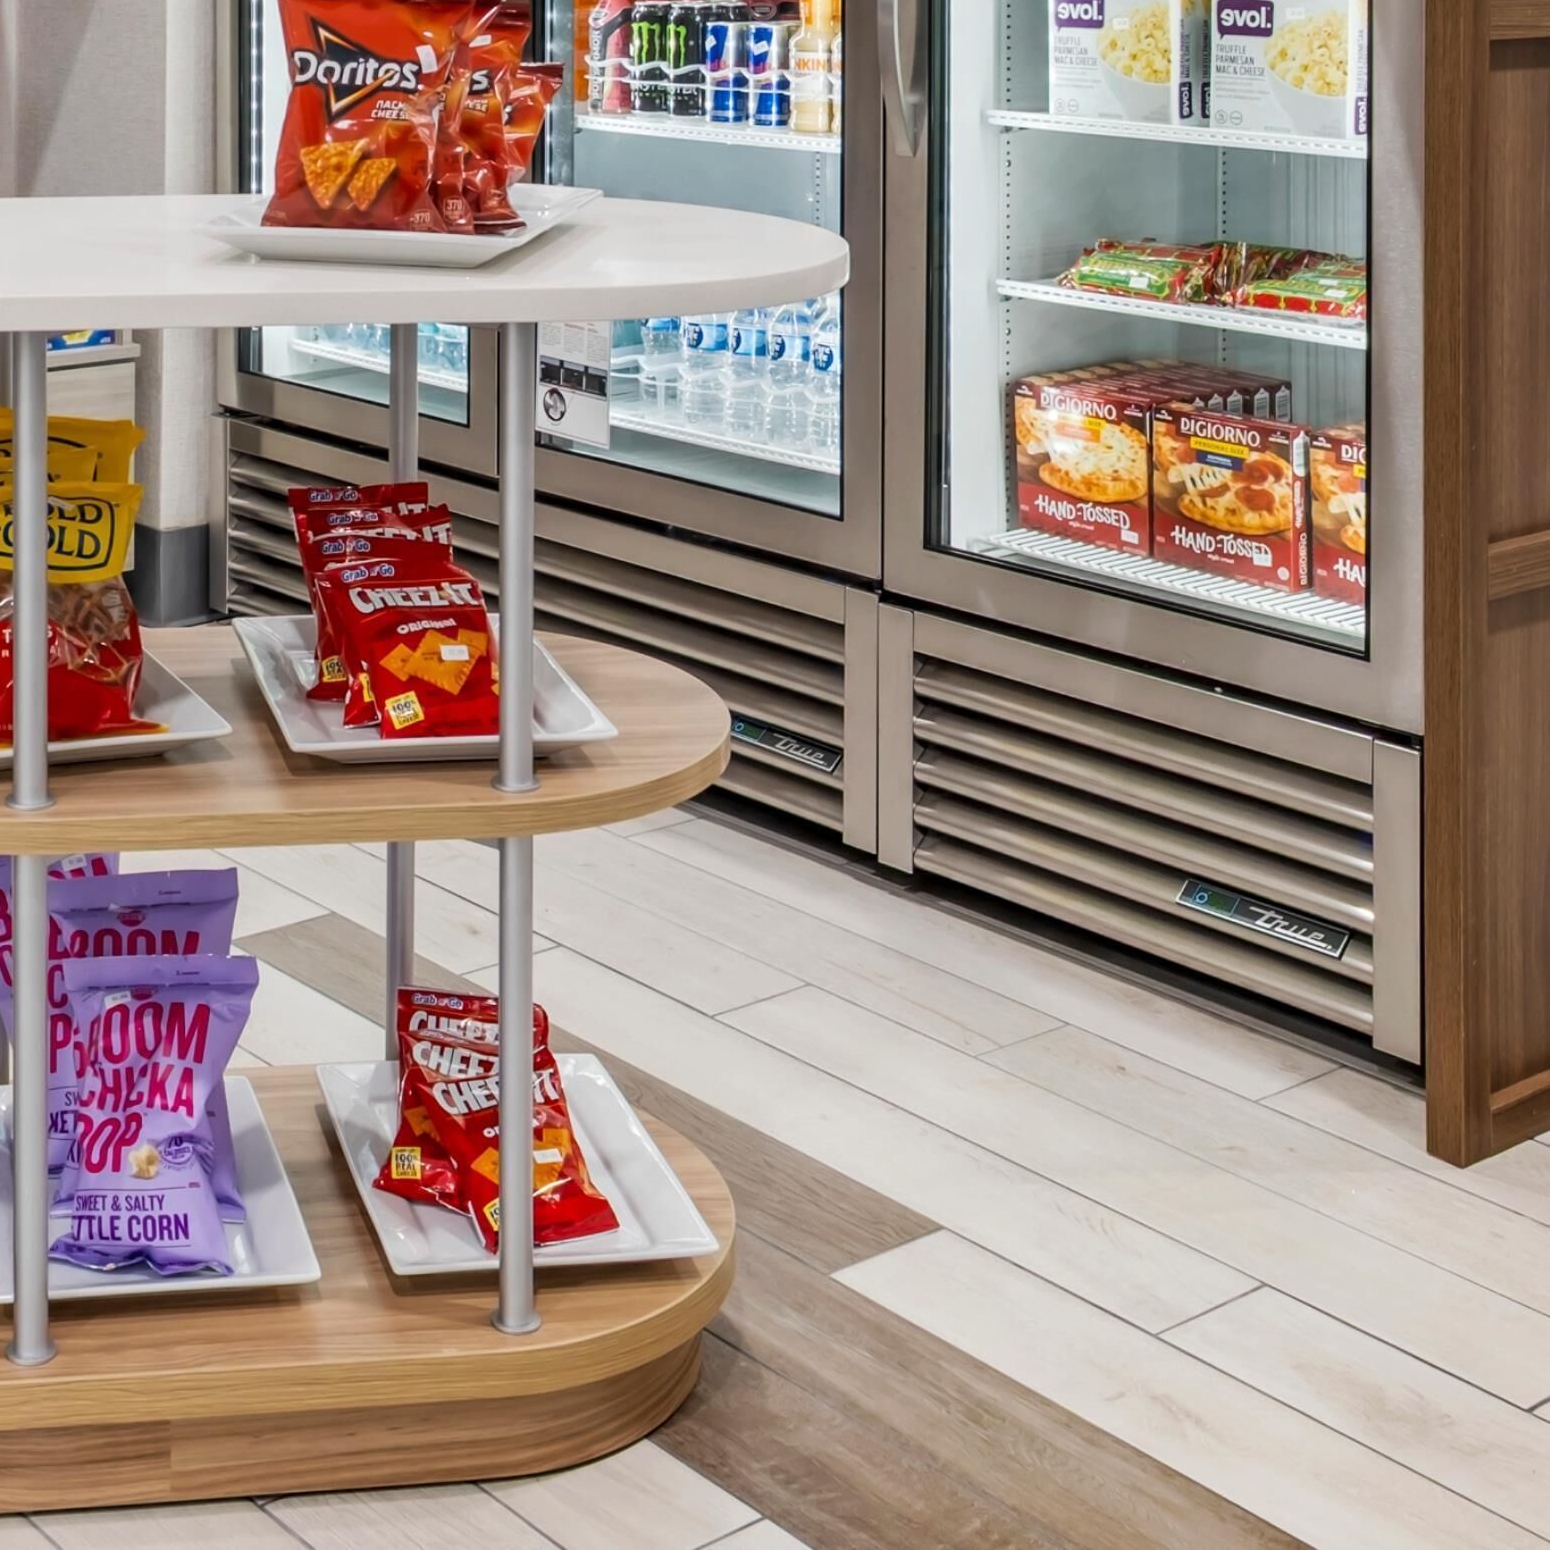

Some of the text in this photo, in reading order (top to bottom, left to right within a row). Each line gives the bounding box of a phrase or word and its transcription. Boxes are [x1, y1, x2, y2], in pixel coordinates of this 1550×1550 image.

[293, 51, 420, 90] Doritos
[1034, 494, 1130, 530] HAND-TOSSED
[342, 569, 368, 583] Grab
[379, 564, 395, 577] Go
[349, 582, 482, 613] CHEEZ-IT
[76, 1194, 165, 1211] SWEET & SALTY
[72, 1213, 190, 1242] TTLE CORN
